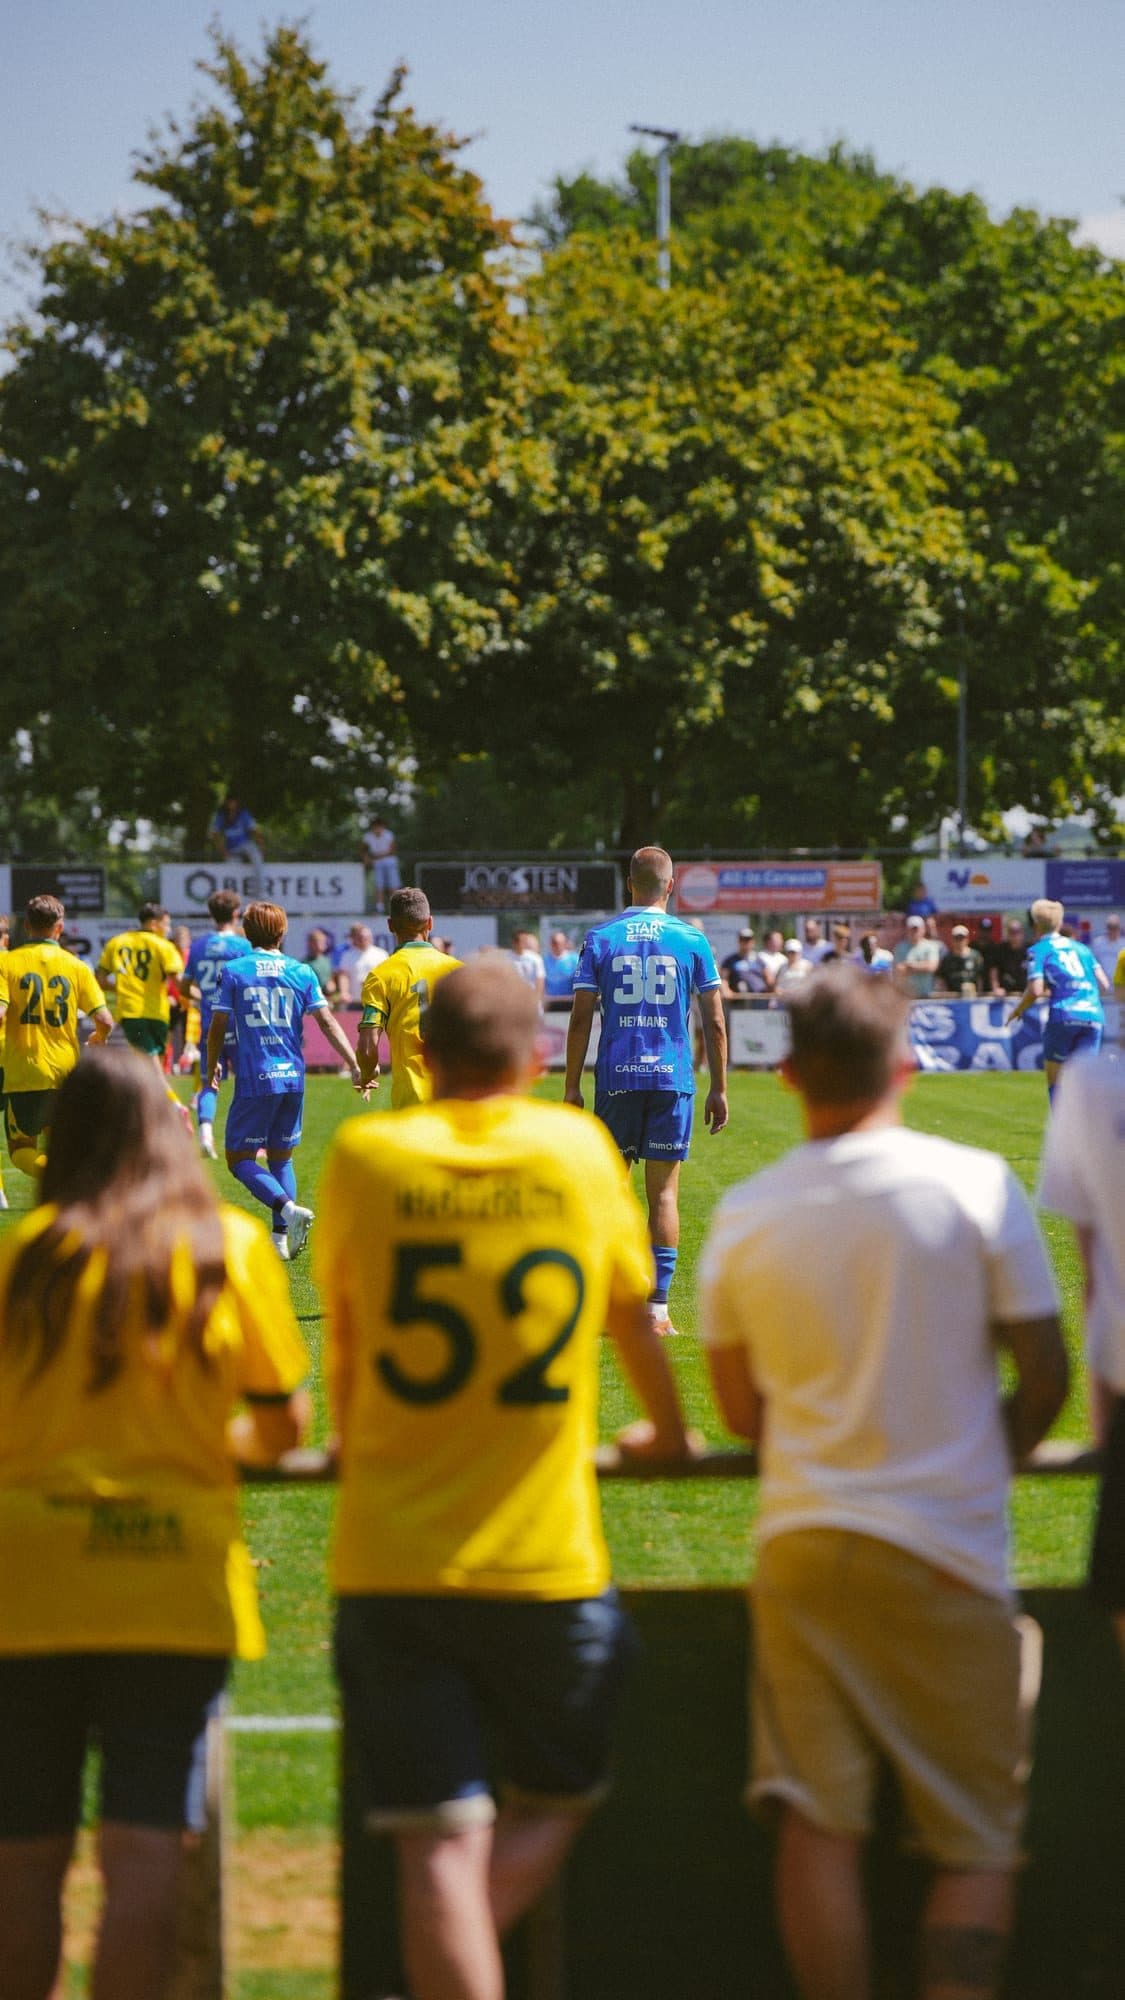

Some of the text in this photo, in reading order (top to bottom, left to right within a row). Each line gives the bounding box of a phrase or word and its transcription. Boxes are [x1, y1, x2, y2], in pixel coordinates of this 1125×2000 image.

[223, 876, 343, 897] BERTELS
[461, 866, 578, 893] JOOSTEN
[612, 955, 677, 1005] 38
[19, 973, 71, 1027] 23
[243, 986, 295, 1028] 30
[619, 1015, 668, 1028] HEYMANS
[615, 1064, 674, 1073] CARGLASS
[374, 1241, 584, 1408] 52
